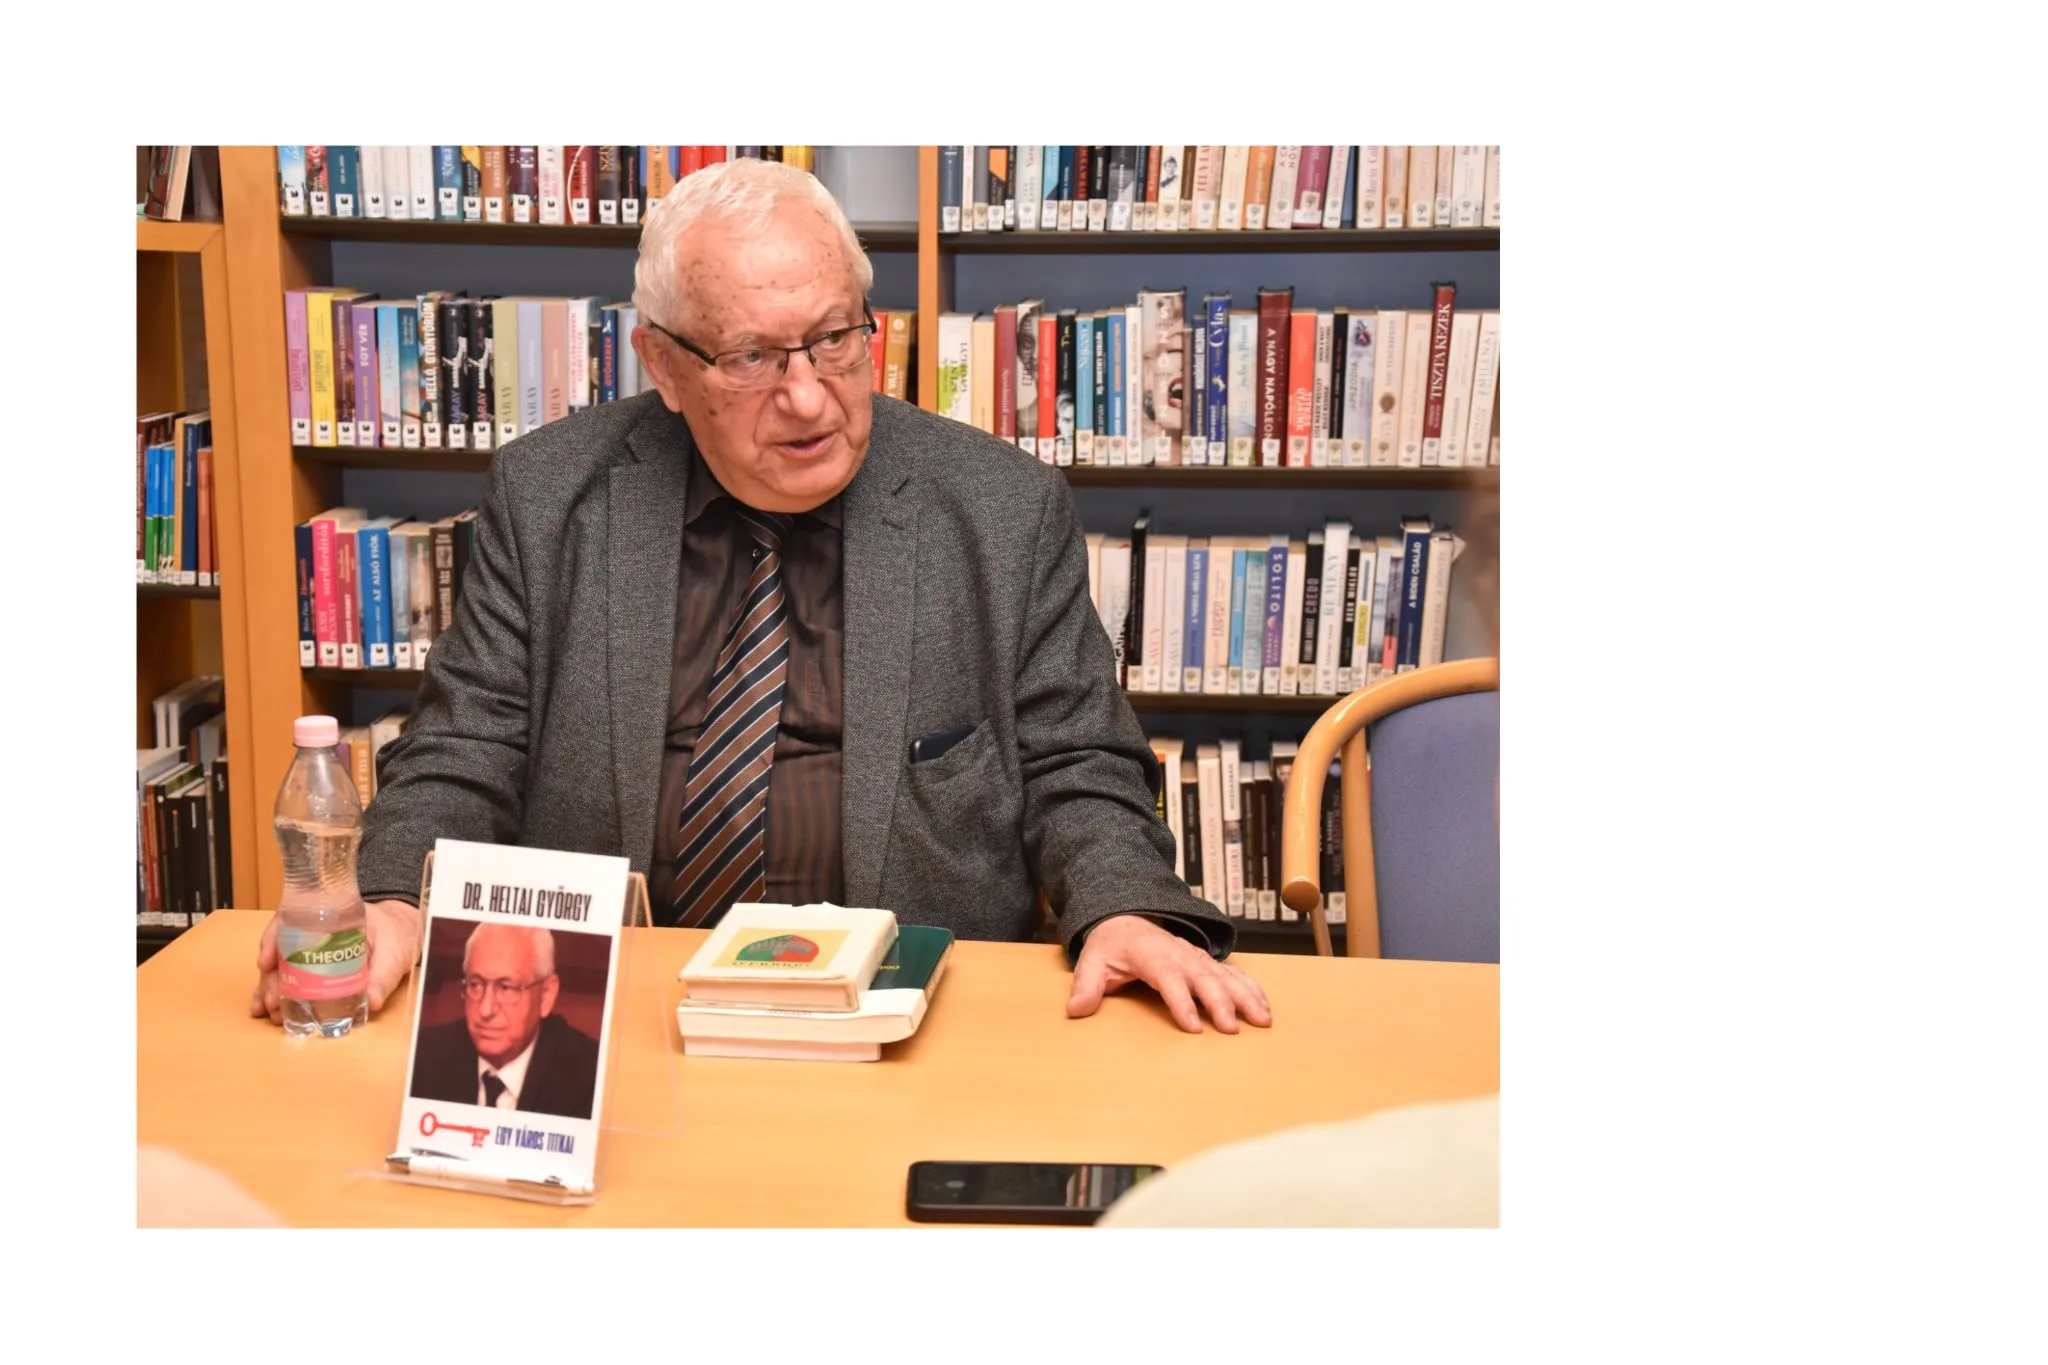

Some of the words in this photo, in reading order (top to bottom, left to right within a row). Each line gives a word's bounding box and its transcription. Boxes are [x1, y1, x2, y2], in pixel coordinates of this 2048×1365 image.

[357, 323, 368, 344] VÉR
[1266, 327, 1276, 337] A
[1434, 303, 1451, 350] KEZEK
[359, 346, 370, 367] EGY
[1265, 340, 1276, 375] NAGY
[1429, 351, 1446, 400] TISZTA
[476, 391, 487, 423] ÁRAY
[550, 388, 560, 418] ÁRAY
[1410, 541, 1422, 575] CSALÁD
[1269, 552, 1284, 613] SOLITO
[1305, 577, 1319, 615] CREDO
[463, 882, 484, 912] DR.
[489, 885, 533, 916] HELTAI
[535, 885, 593, 923] GYÖRGY
[494, 1126, 513, 1147] EGY
